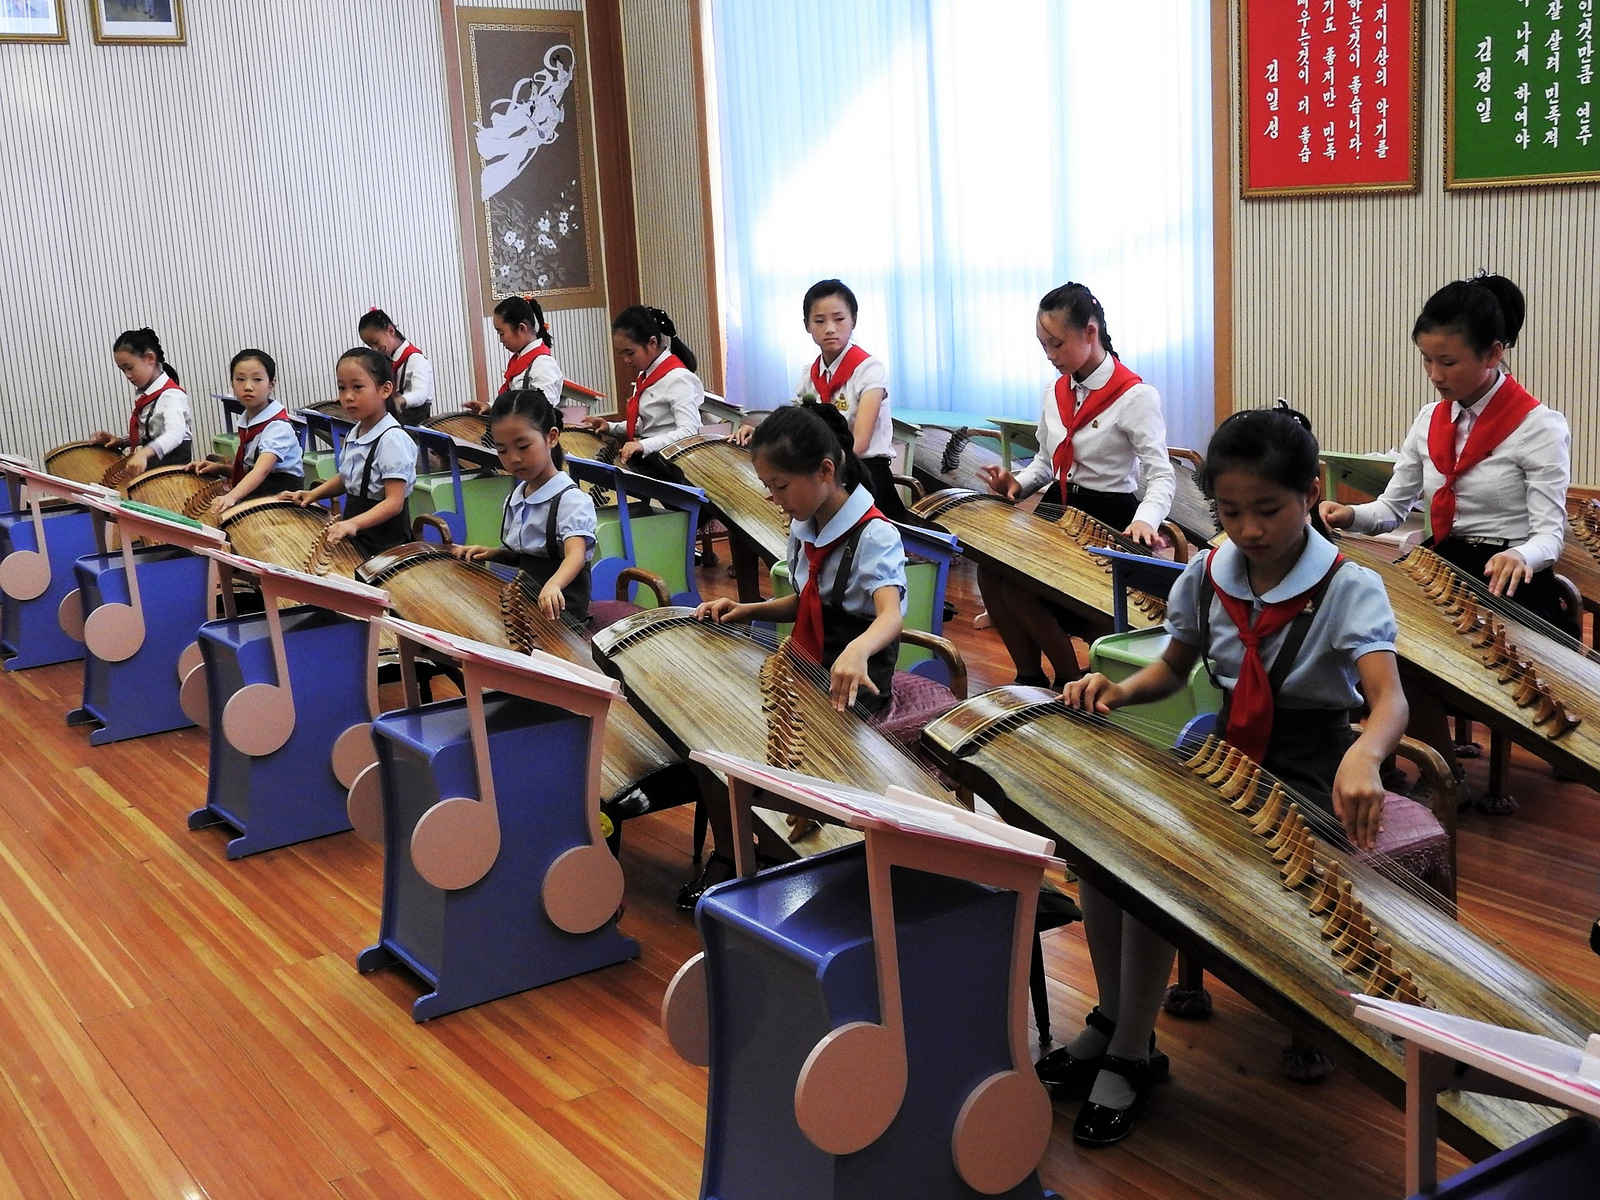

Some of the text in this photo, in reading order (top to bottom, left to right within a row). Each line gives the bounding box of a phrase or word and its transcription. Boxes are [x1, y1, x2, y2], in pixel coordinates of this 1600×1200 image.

[1322, 0, 1337, 161] 기도 좋지만 민족
[1347, 0, 1363, 160] 하는것이 좋습니다.
[1374, 0, 1390, 159] 지이상의 악기를
[1473, 36, 1492, 123] 김정일
[1514, 21, 1532, 66] 나게
[1542, 0, 1563, 149] 잘 살려 민족적
[1576, 0, 1595, 146] 인것만큼 연주
[1263, 59, 1279, 139] 김일성
[1298, 95, 1309, 115] 더
[1514, 82, 1531, 150] 하여야
[1298, 126, 1312, 163] 좋습
